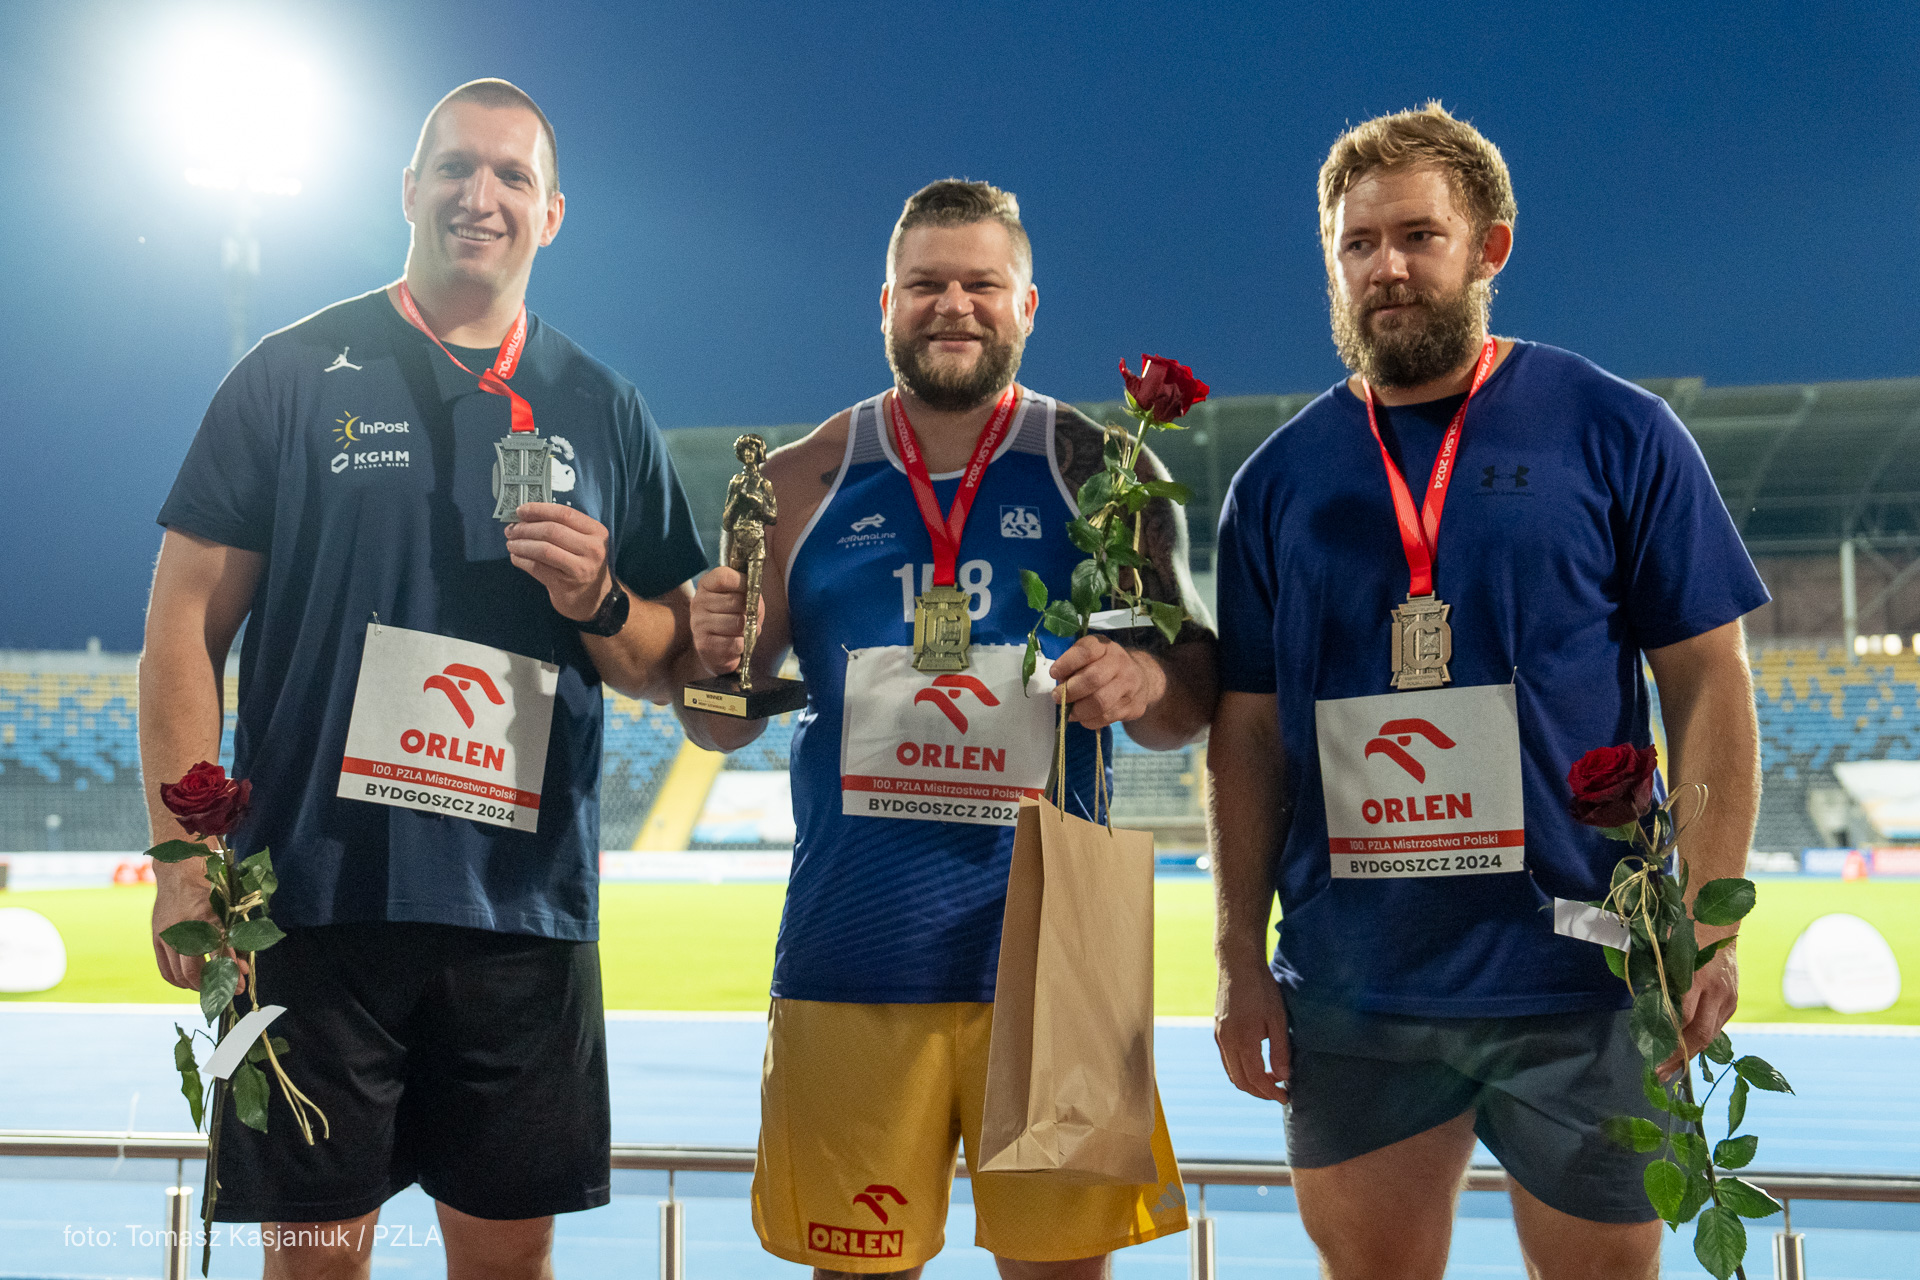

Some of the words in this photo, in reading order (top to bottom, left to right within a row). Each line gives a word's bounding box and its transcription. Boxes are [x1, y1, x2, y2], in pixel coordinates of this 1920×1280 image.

[360, 421, 410, 434] InPost
[1442, 415, 1460, 457] POLSKI
[354, 450, 410, 465] KGHM
[976, 431, 997, 464] POLSKI
[965, 463, 982, 488] 2024
[1433, 459, 1449, 489] 2024
[400, 729, 506, 772] ORLEN
[896, 741, 1006, 772] ORLEN
[372, 763, 394, 778] 100.
[396, 768, 423, 782] PZLA
[425, 773, 488, 794] Mistrzostwa
[489, 786, 517, 801] Polski
[872, 778, 894, 791] 100.
[895, 780, 921, 792] PZLA
[924, 782, 989, 797] Mistrzostwa
[365, 783, 474, 814] BYDGOSZCZ
[477, 803, 515, 823] 2024
[868, 799, 977, 818] BYDGOSZCZ
[981, 806, 1019, 821] 202
[1362, 793, 1473, 825] ORLEN
[1368, 840, 1391, 851] PZLA
[1393, 836, 1461, 850] Mistrzostwa
[1463, 833, 1499, 846] Polski
[1350, 857, 1451, 873] BYDGOSZCZ
[1455, 854, 1502, 870] 2024
[811, 1227, 900, 1254] ORLEN
